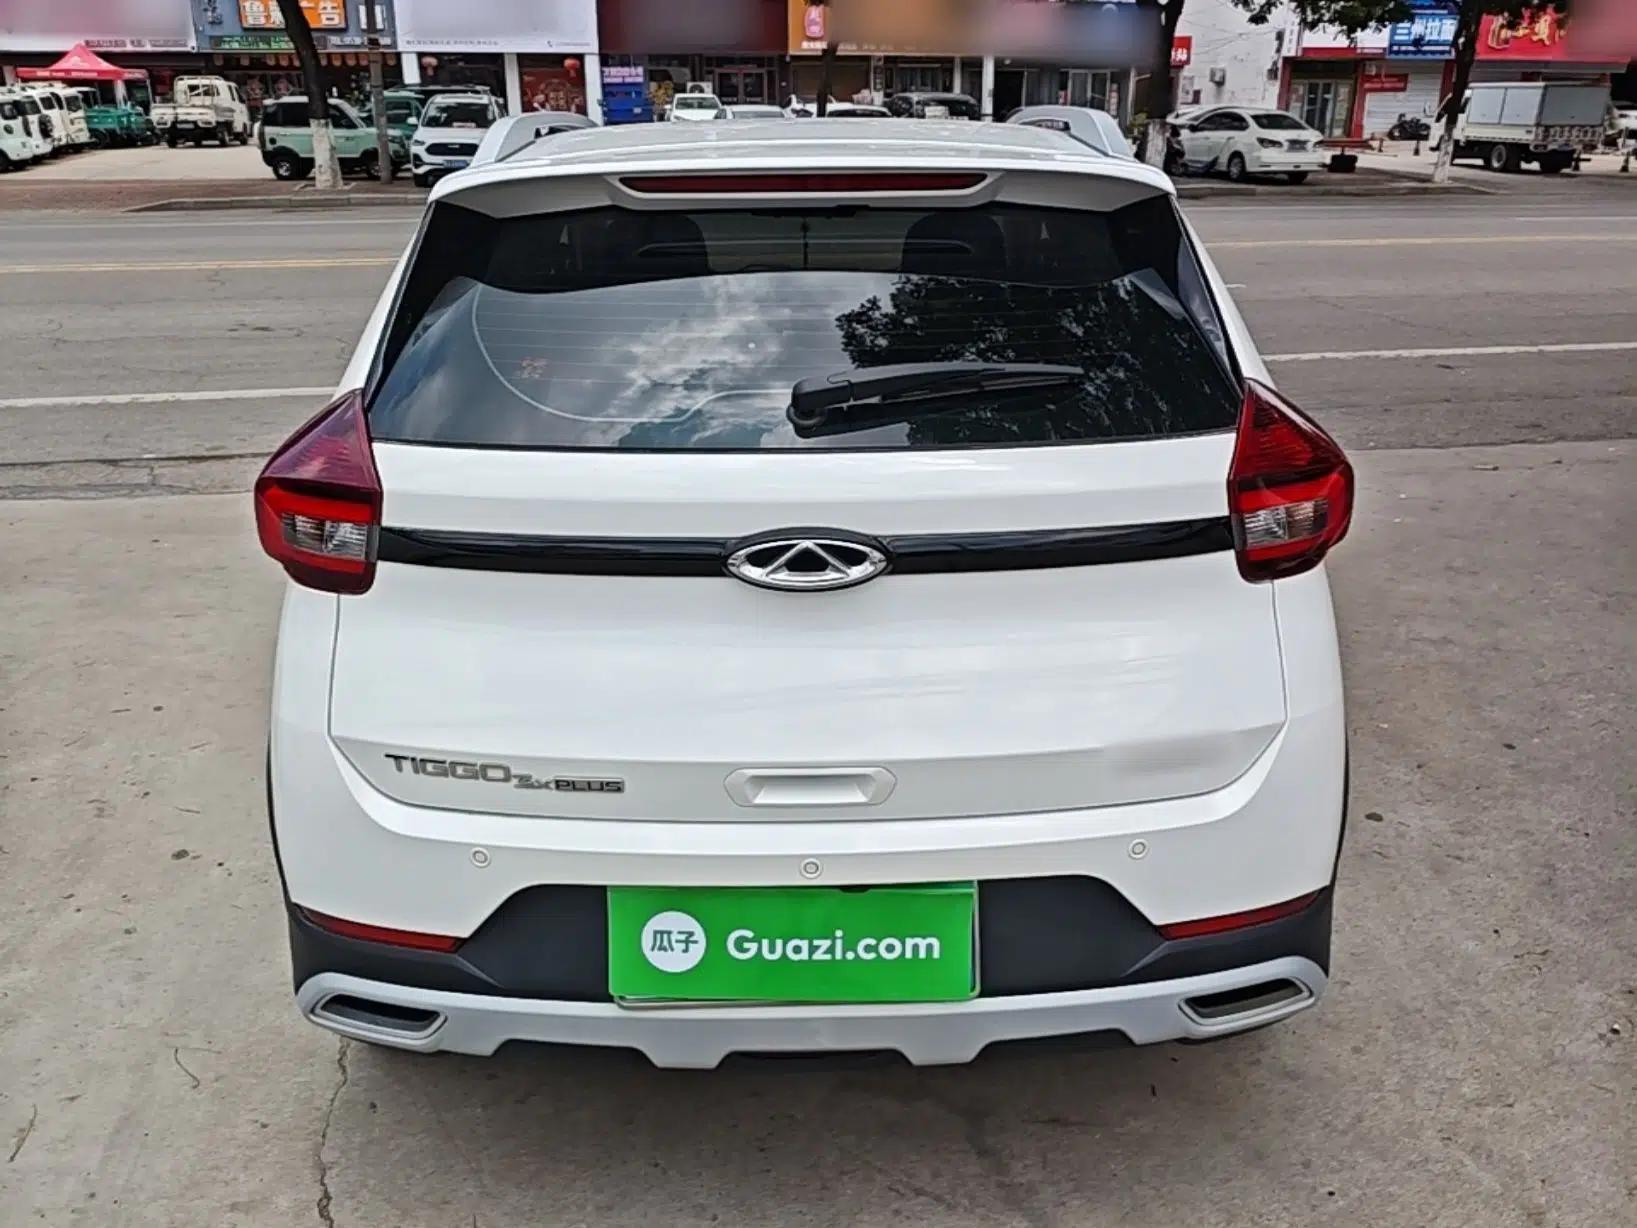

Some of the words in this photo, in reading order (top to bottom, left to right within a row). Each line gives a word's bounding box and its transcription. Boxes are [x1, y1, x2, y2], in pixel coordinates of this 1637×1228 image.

[385, 753, 511, 783] TIGGO
[555, 776, 624, 793] PLUS
[651, 929, 699, 954] 瓜子
[726, 929, 940, 961] Guazi.com
